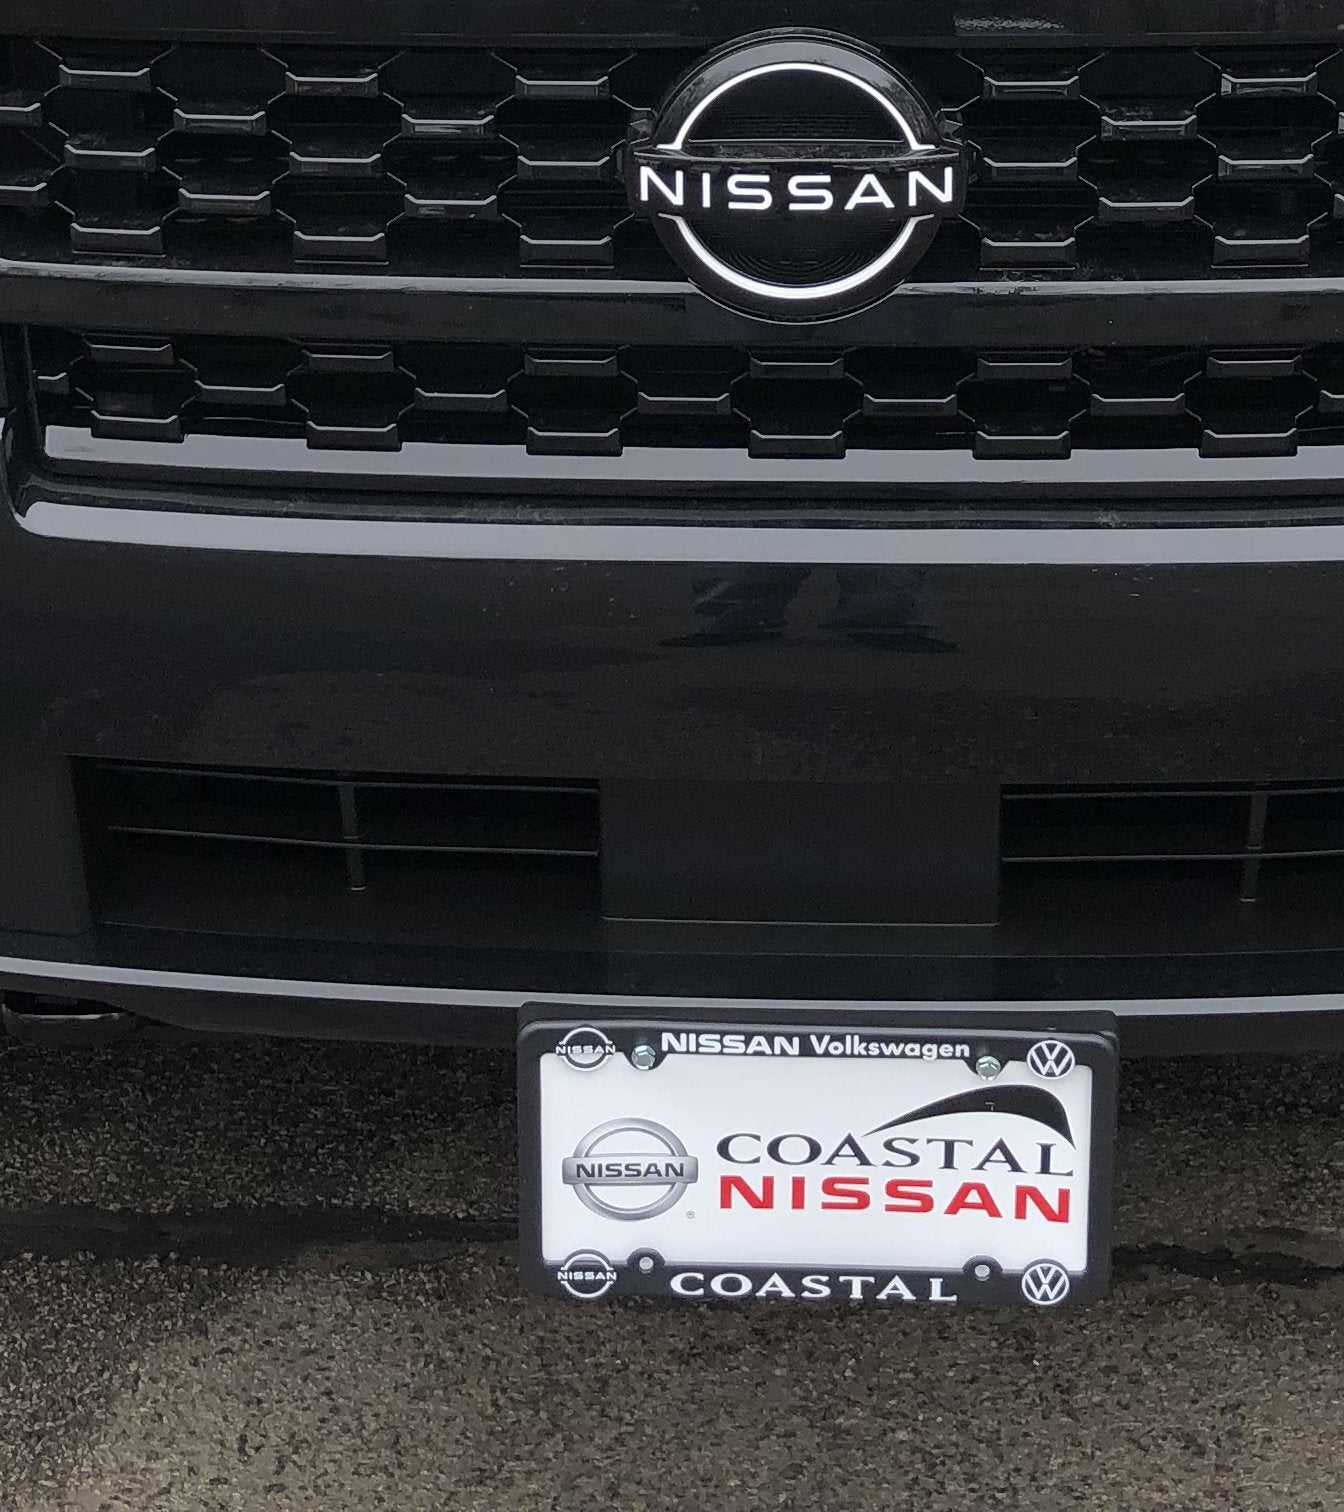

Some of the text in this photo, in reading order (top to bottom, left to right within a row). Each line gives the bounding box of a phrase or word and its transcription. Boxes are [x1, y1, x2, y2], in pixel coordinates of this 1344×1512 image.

[639, 166, 954, 211] NISSAN
[556, 1044, 616, 1055] NISSAN
[661, 1032, 970, 1061] NISSAN Volkswagen
[716, 1132, 1074, 1177] COASTAL
[576, 1162, 684, 1178] NISSAN
[719, 1175, 1070, 1223] NISSAN
[557, 1270, 617, 1282] NISSAN
[670, 1272, 958, 1301] COASTAL
